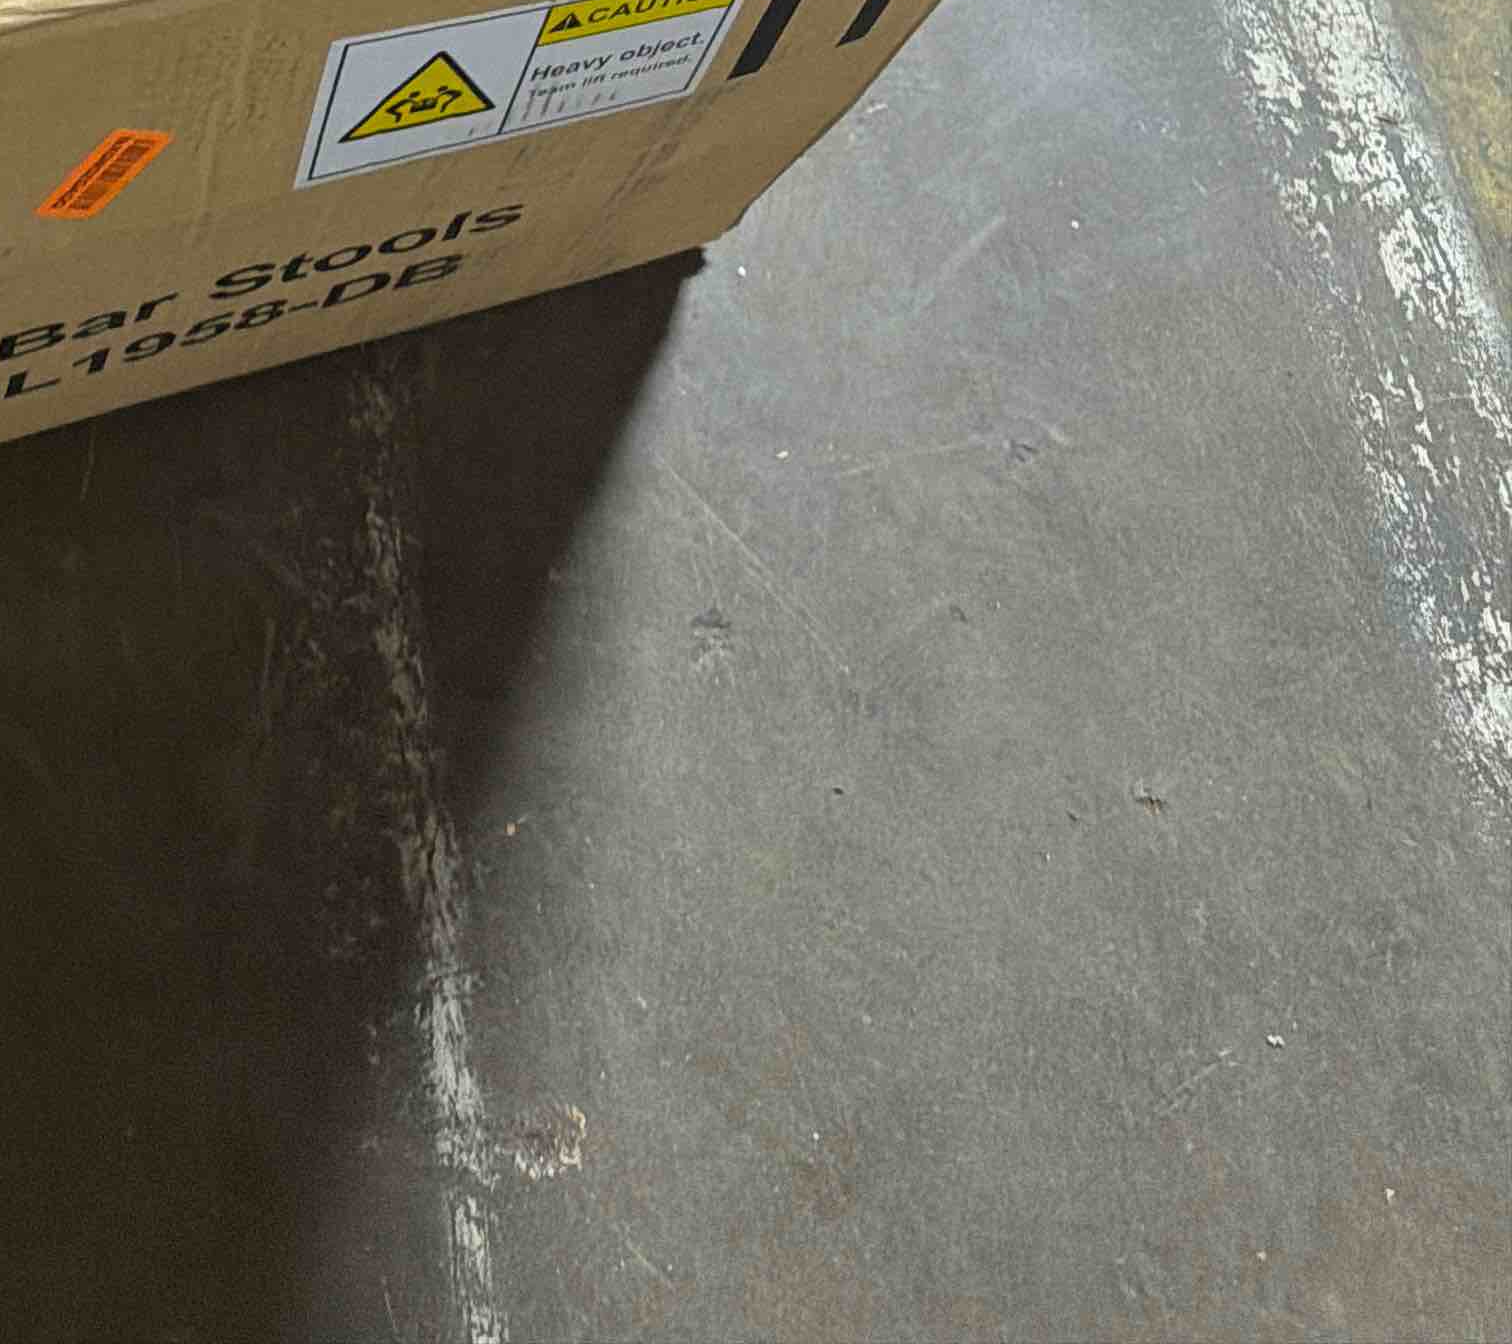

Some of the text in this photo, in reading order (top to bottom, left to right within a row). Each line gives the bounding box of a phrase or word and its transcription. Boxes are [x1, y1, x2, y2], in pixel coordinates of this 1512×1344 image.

[530, 31, 704, 82] Heavy object.
[208, 201, 526, 301] Stools
